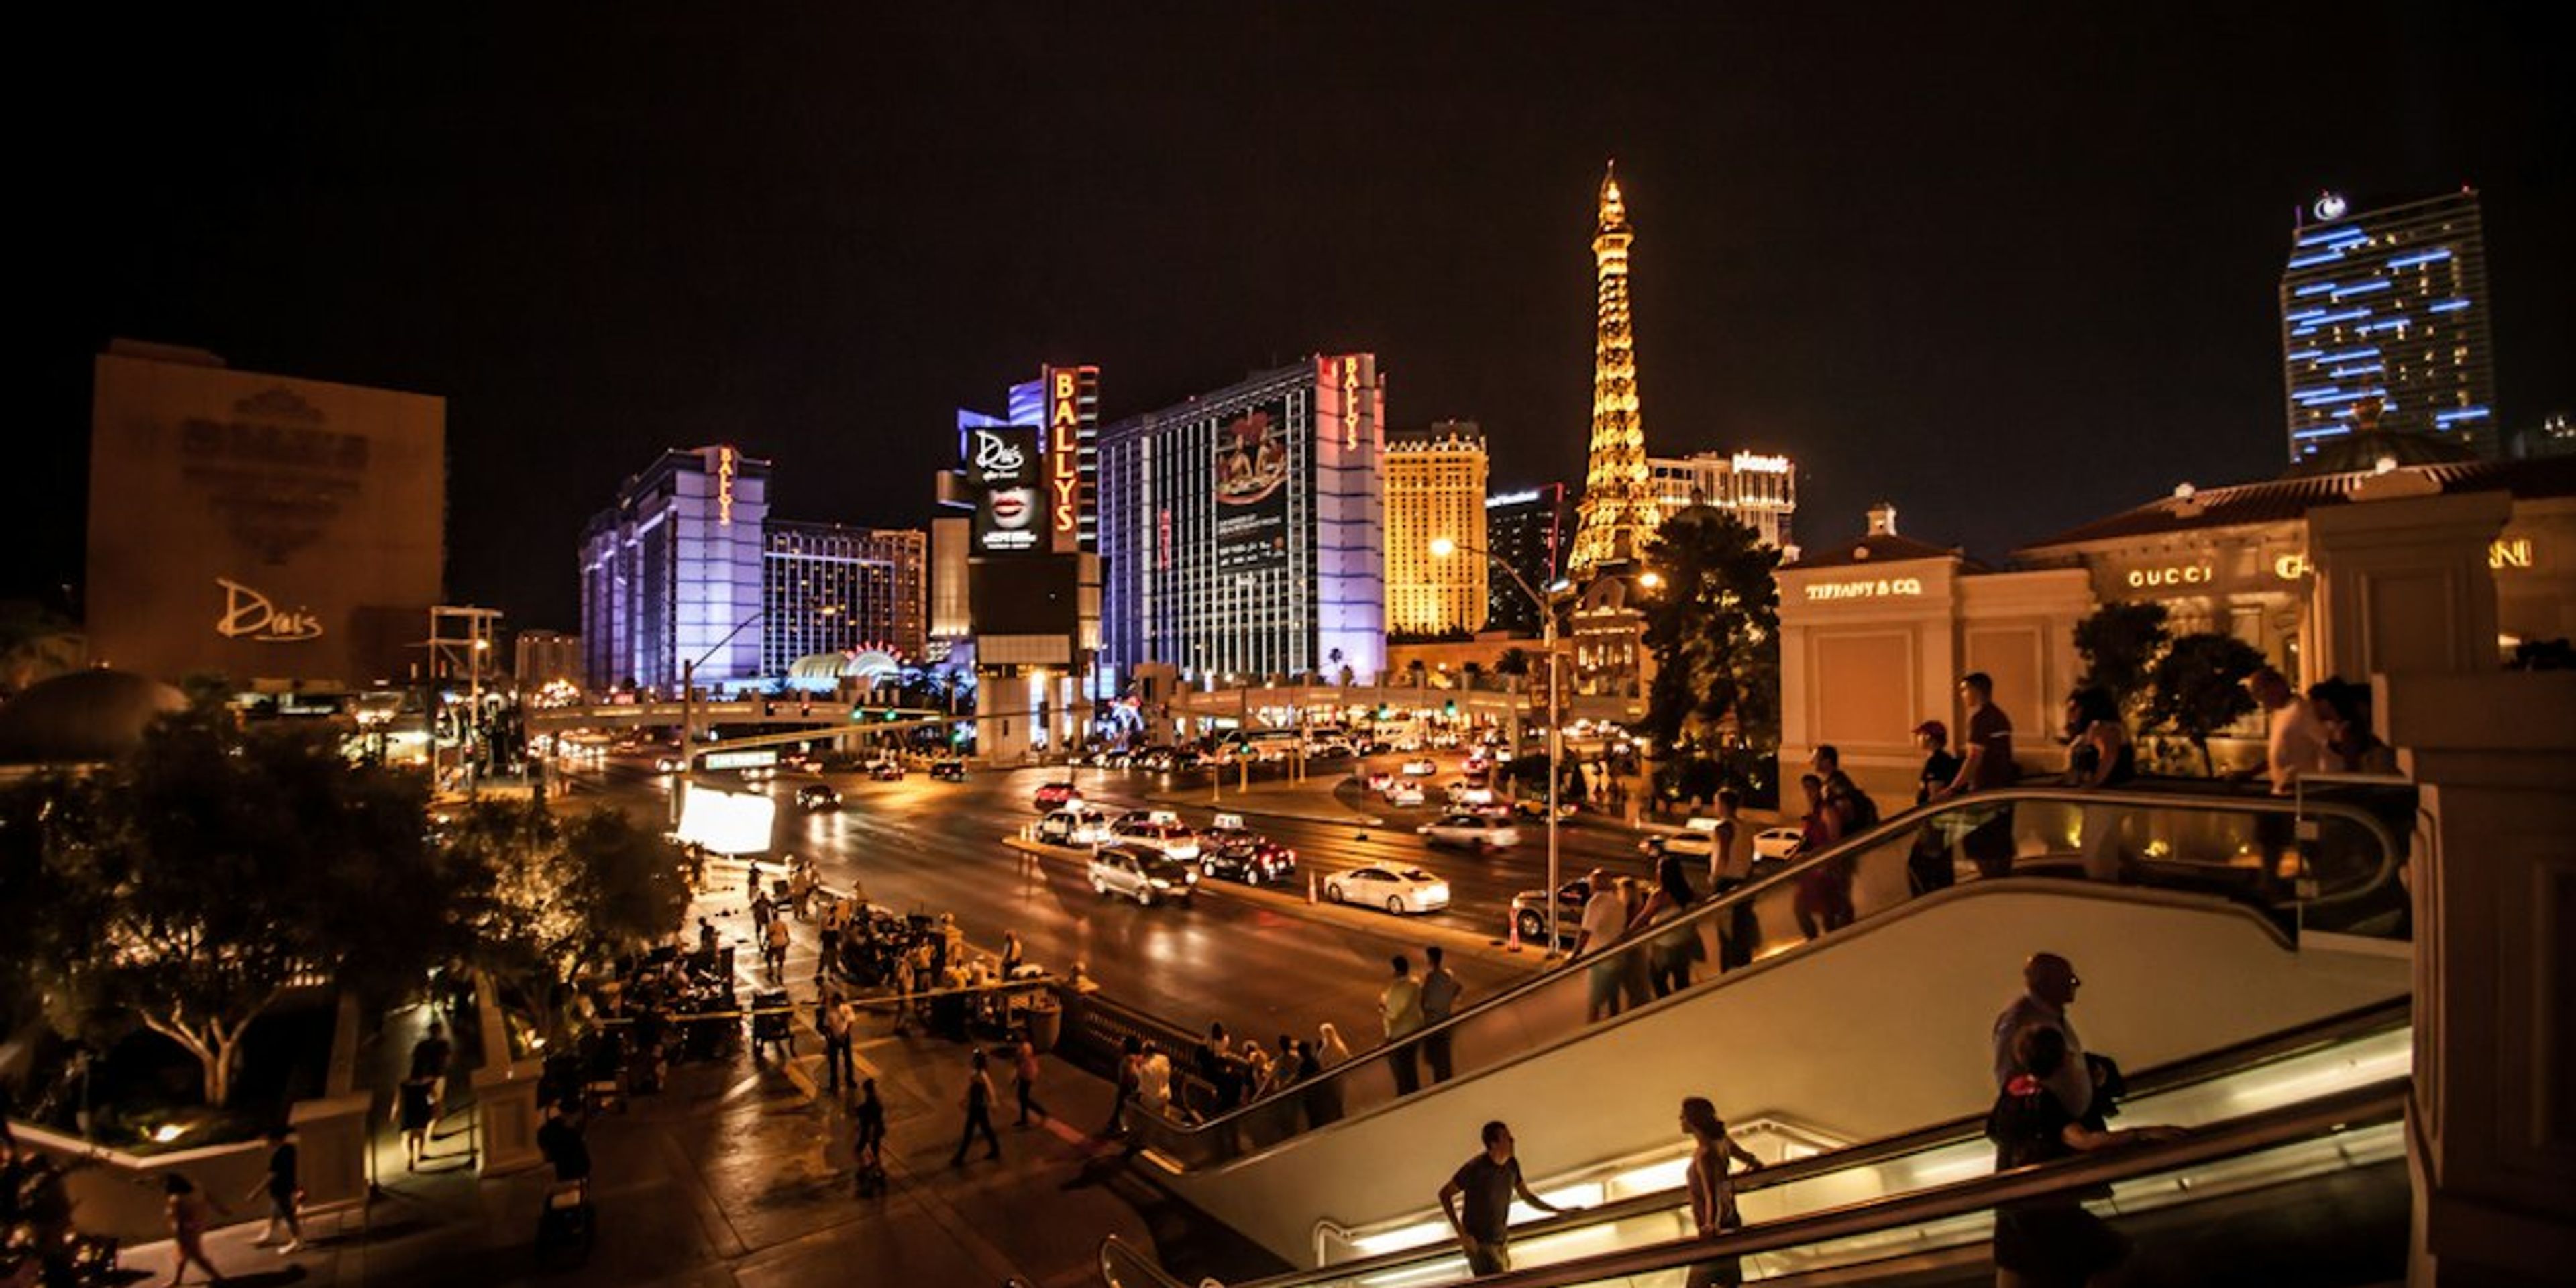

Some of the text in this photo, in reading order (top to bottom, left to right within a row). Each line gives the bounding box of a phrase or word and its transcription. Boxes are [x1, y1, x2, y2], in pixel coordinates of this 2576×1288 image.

[1345, 357, 1358, 451] BALLYS
[719, 447, 733, 526] BALLYS
[1054, 374, 1076, 531] BALLYS
[1805, 582, 1874, 599] TIFFANY
[1877, 580, 1889, 595] &
[2129, 566, 2212, 587] GUCCI
